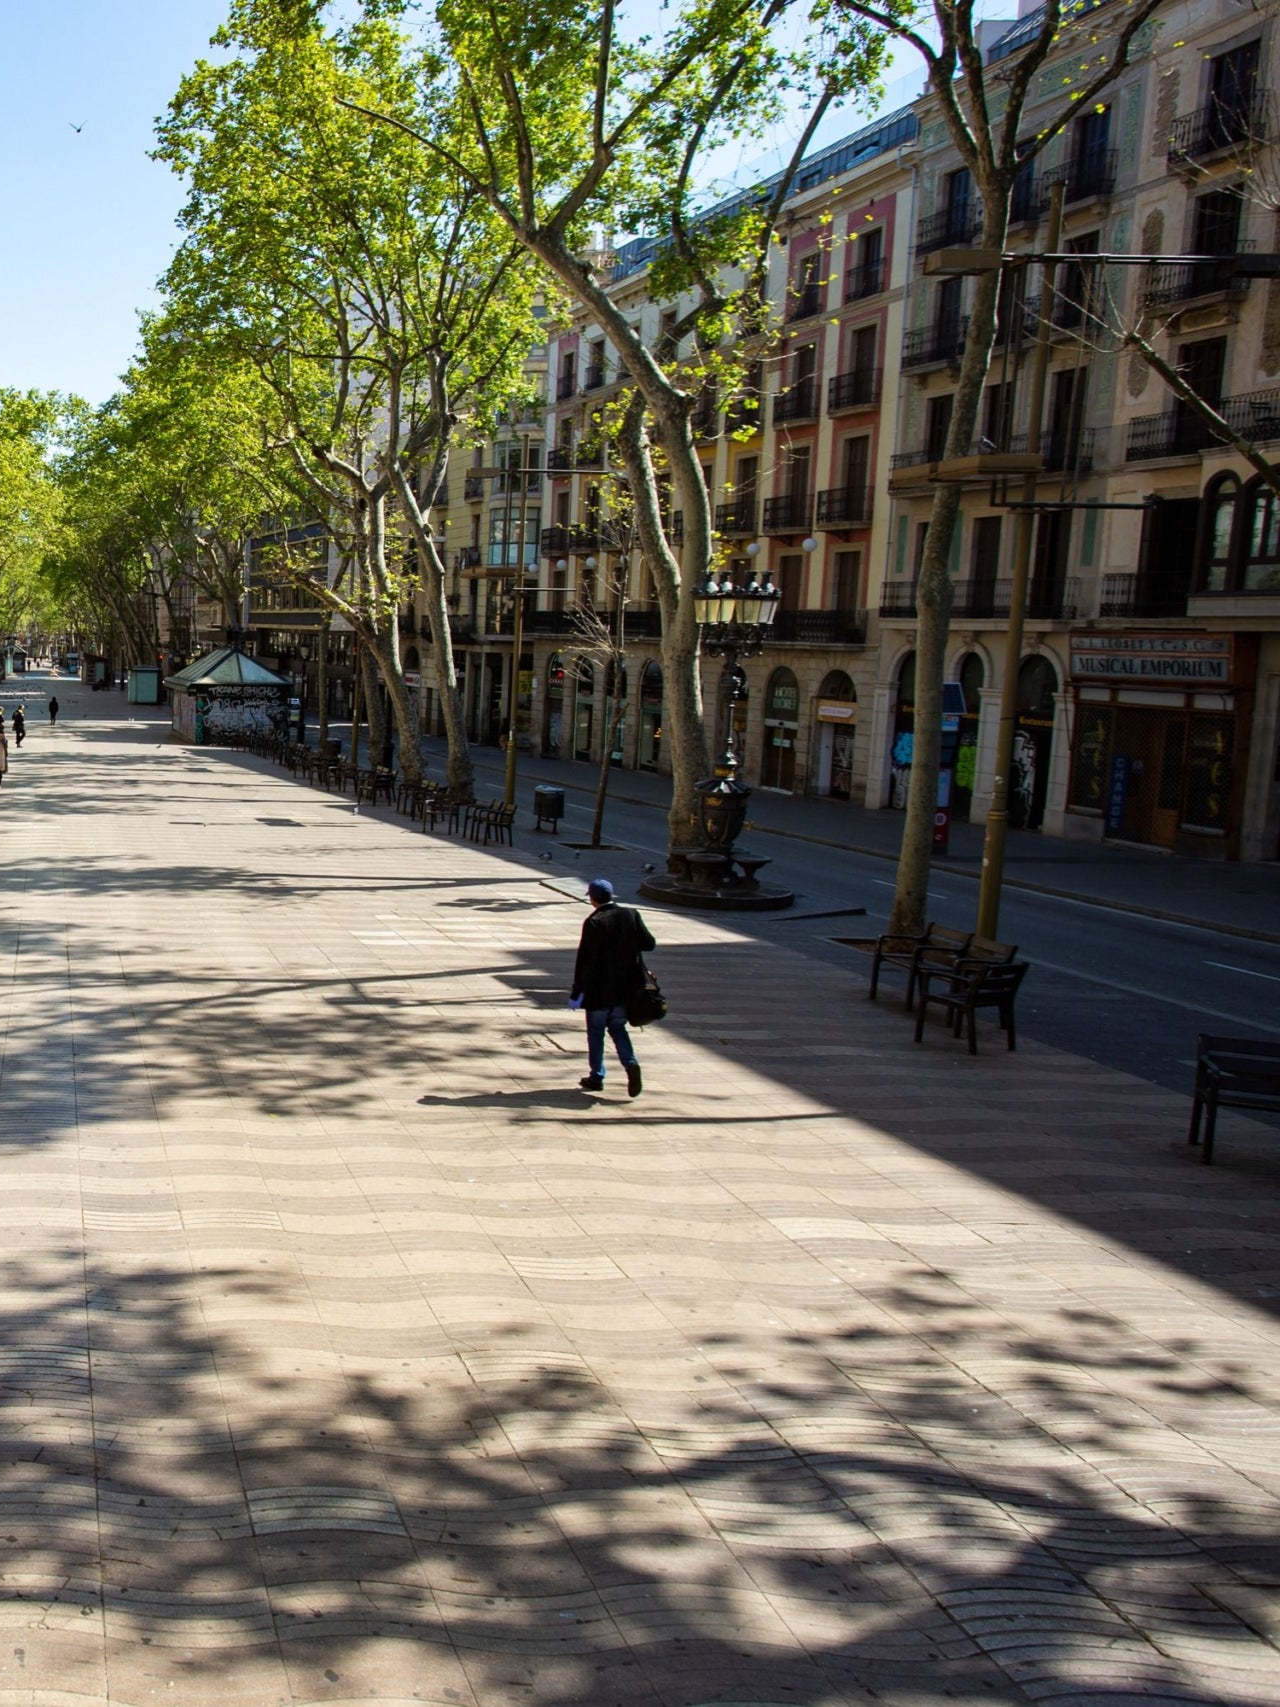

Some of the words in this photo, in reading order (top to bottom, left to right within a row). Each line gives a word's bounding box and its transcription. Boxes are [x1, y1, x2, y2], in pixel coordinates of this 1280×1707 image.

[1079, 656, 1137, 675] MUSICAL
[1140, 659, 1222, 678] EMPORIUM
[1110, 757, 1126, 828] CHANGE
